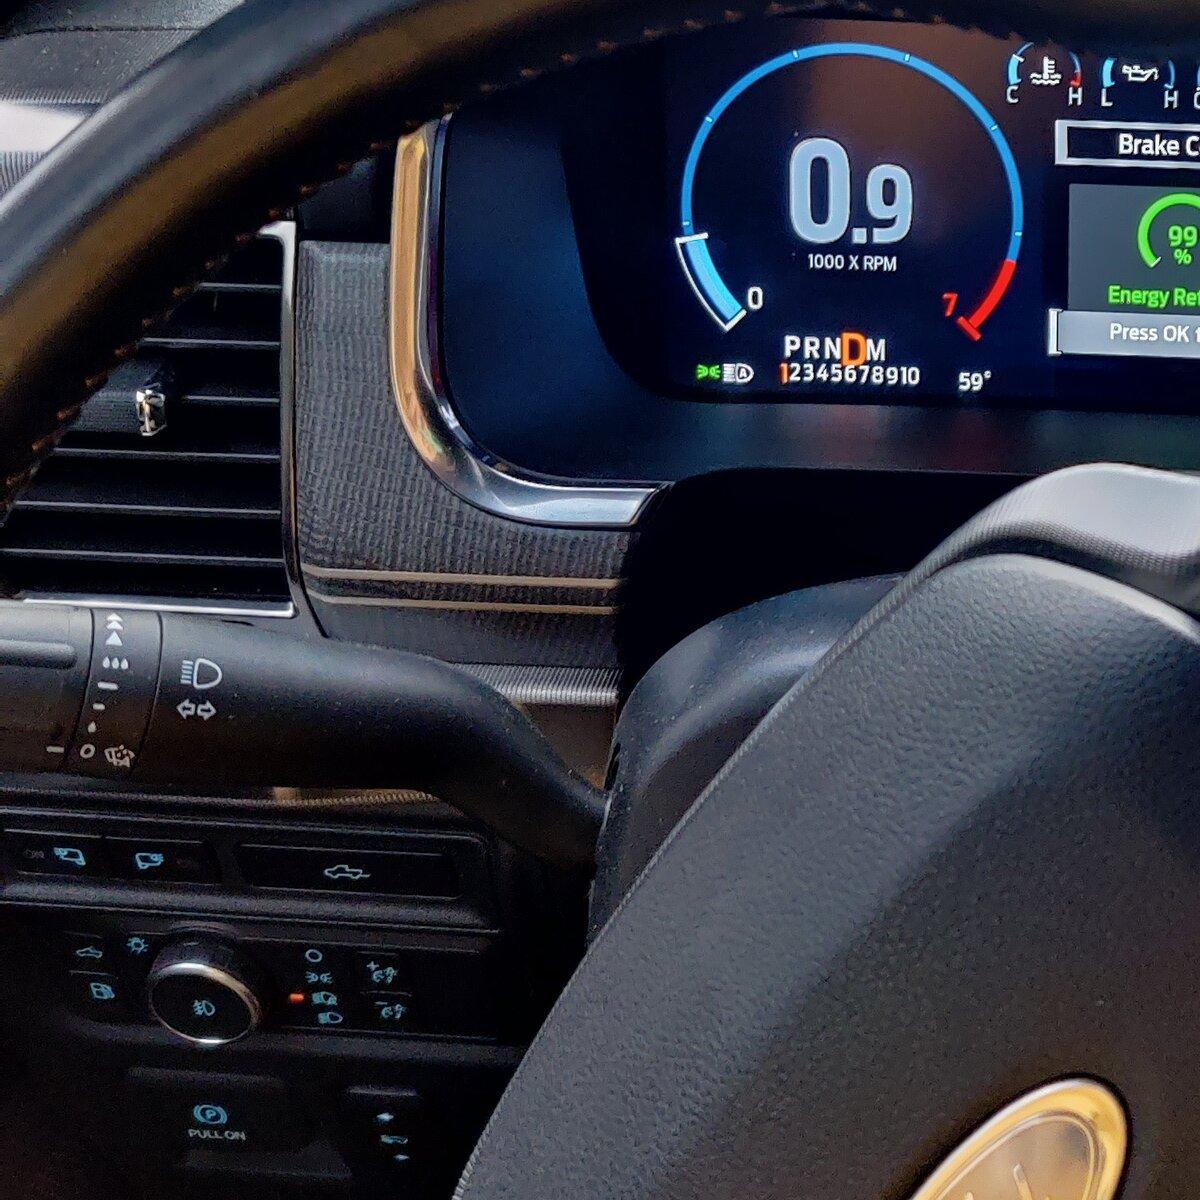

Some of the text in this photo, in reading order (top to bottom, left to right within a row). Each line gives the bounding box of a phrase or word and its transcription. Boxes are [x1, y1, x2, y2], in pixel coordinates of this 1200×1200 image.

[1068, 87, 1083, 106] H
[1163, 90, 1179, 109] H
[1118, 132, 1180, 157] Brake
[789, 137, 914, 244] 0.9
[1168, 225, 1199, 247] 99
[807, 253, 898, 272] 1000 X RPM
[1173, 249, 1192, 265] %
[747, 286, 763, 310] 0
[943, 293, 957, 316] 7
[1108, 285, 1169, 309] Energy
[1109, 322, 1158, 341] Press
[1163, 325, 1190, 342] OK
[188, 1128, 246, 1141] PULL ON
